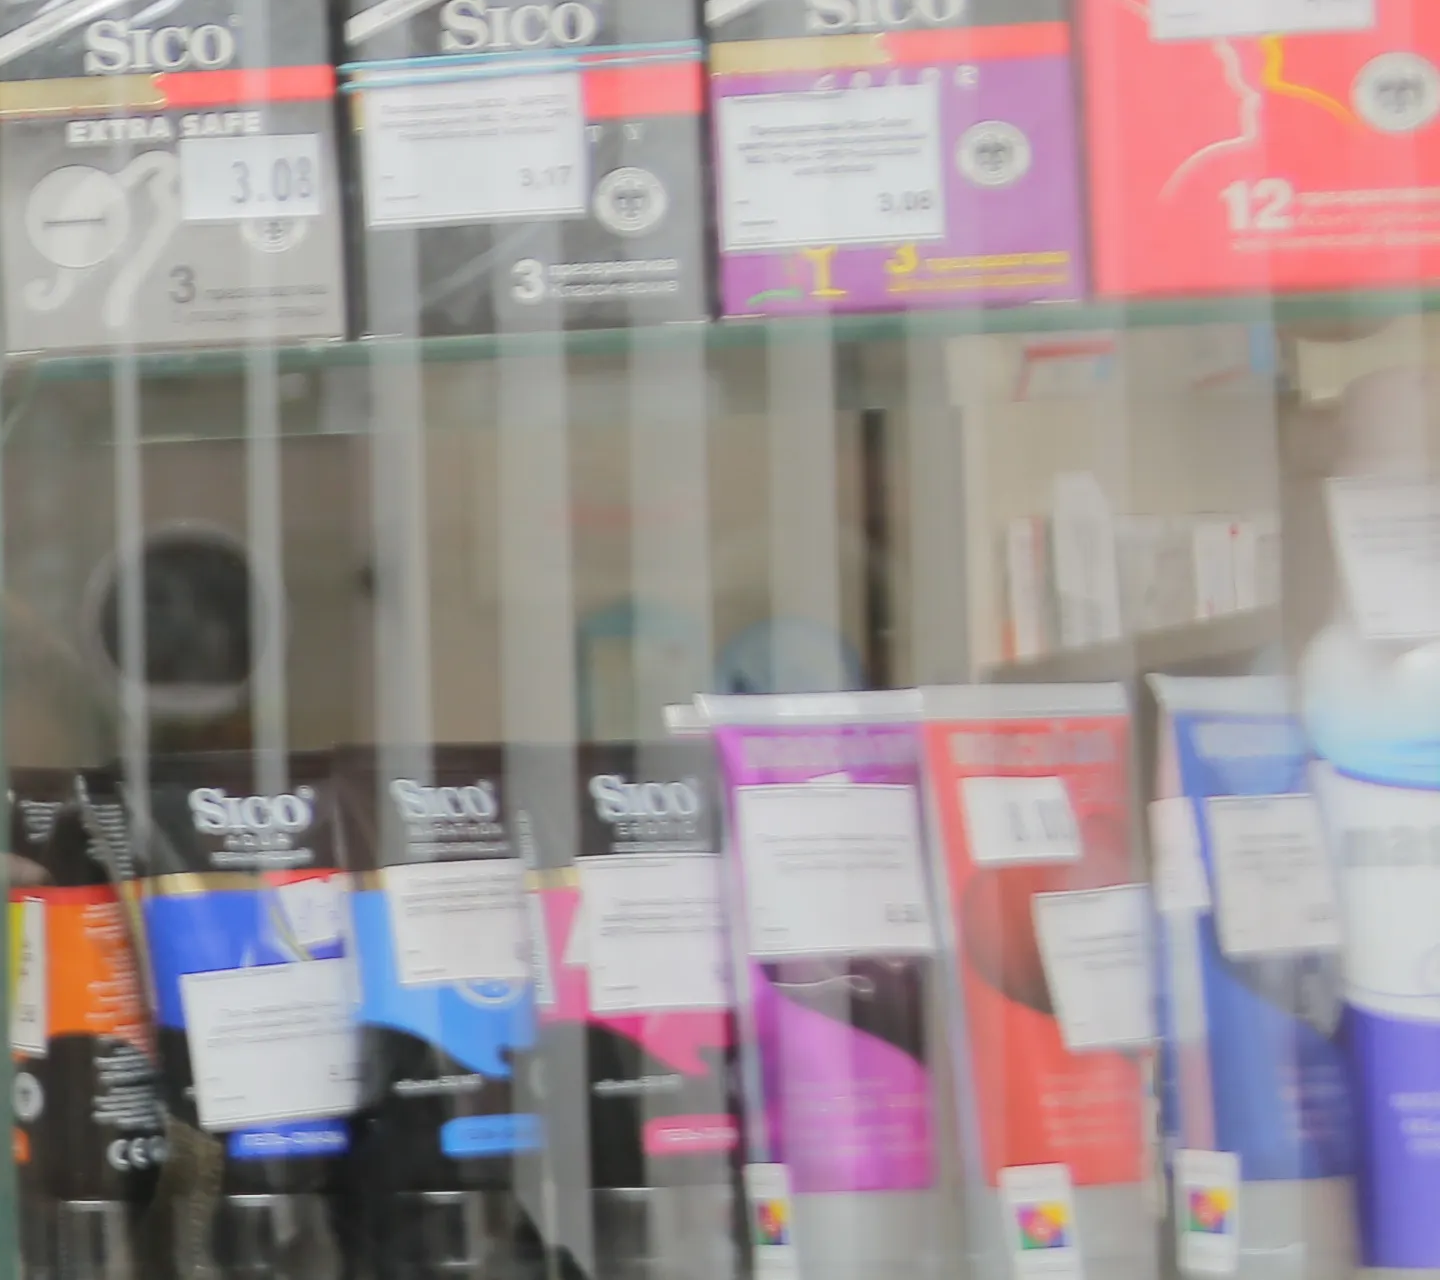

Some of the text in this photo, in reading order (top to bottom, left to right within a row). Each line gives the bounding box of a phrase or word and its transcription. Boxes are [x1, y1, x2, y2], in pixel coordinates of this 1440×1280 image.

[66, 111, 262, 145] EXTRA SAFE
[230, 155, 313, 205] 3.08
[1218, 177, 1295, 232] 12
[168, 263, 197, 304] 3
[508, 257, 547, 307] 3
